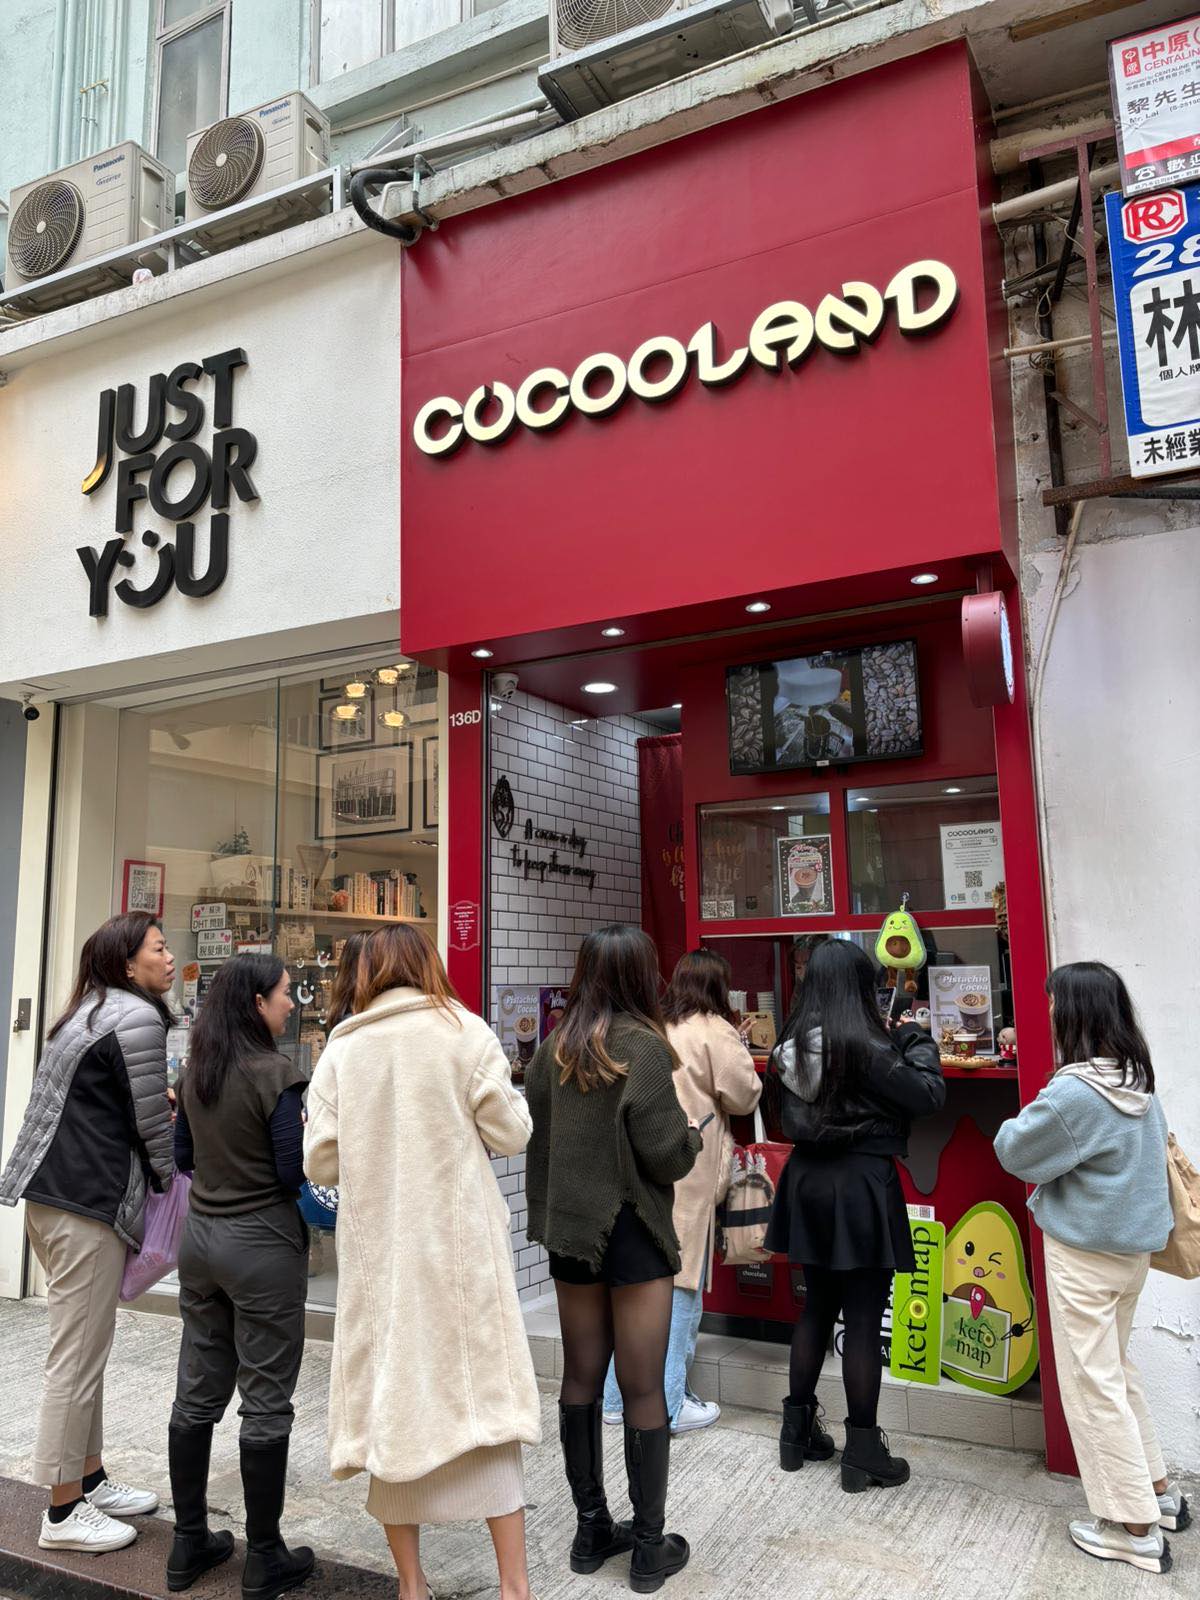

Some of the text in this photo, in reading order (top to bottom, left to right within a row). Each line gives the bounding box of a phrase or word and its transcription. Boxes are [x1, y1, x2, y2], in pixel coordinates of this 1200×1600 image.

[259, 99, 291, 118] Panasonic
[93, 154, 125, 172] Panasonic
[413, 260, 960, 458] COCOOLAND
[81, 347, 248, 495] JUST
[115, 428, 260, 534] FOR
[449, 709, 481, 727] 136D
[942, 974, 989, 984] Pistachio
[959, 983, 989, 992] Cocoa
[505, 995, 537, 1004] Pistachio
[517, 1004, 537, 1014] Cocoa
[956, 1340, 991, 1370] map
